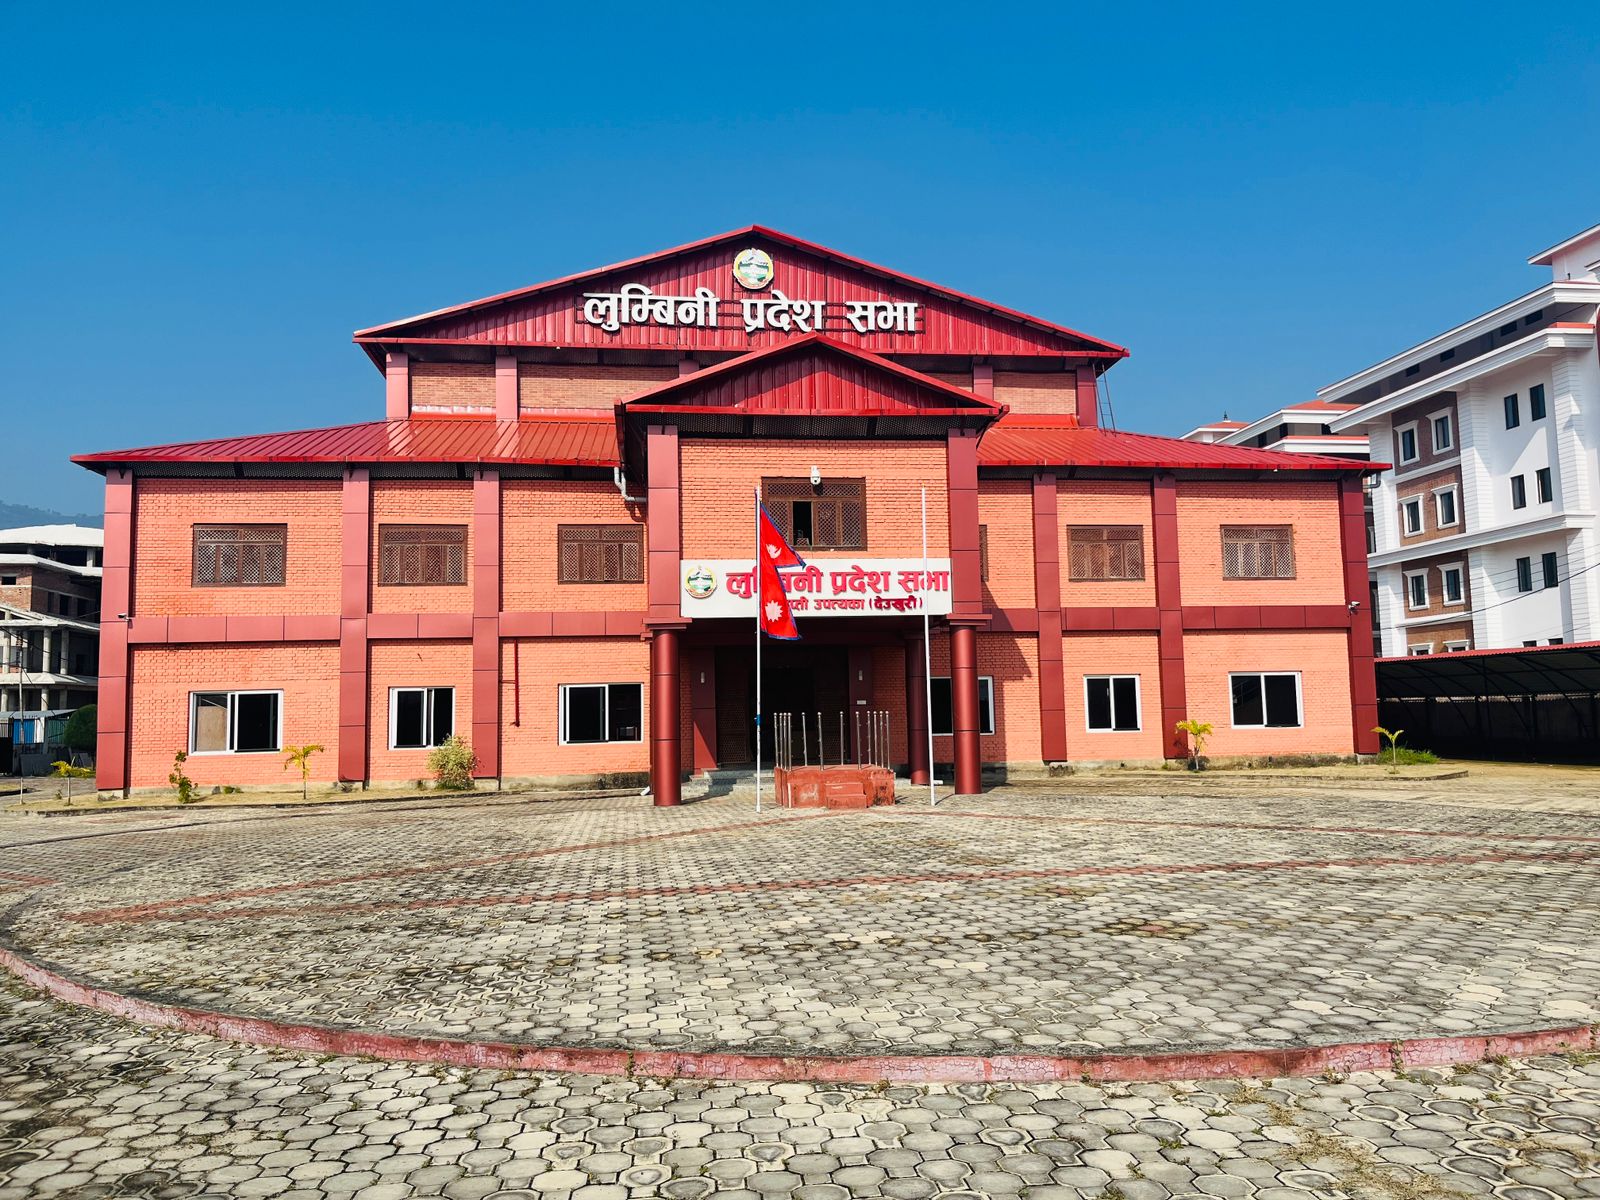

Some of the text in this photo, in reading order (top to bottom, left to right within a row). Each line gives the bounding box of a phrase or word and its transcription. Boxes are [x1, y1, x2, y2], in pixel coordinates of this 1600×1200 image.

[583, 283, 918, 333] लुम्बिनी प्रदेश सभा
[830, 564, 891, 595] प्रदेश
[898, 570, 950, 593] सभा
[814, 599, 865, 610] उपत्यका
